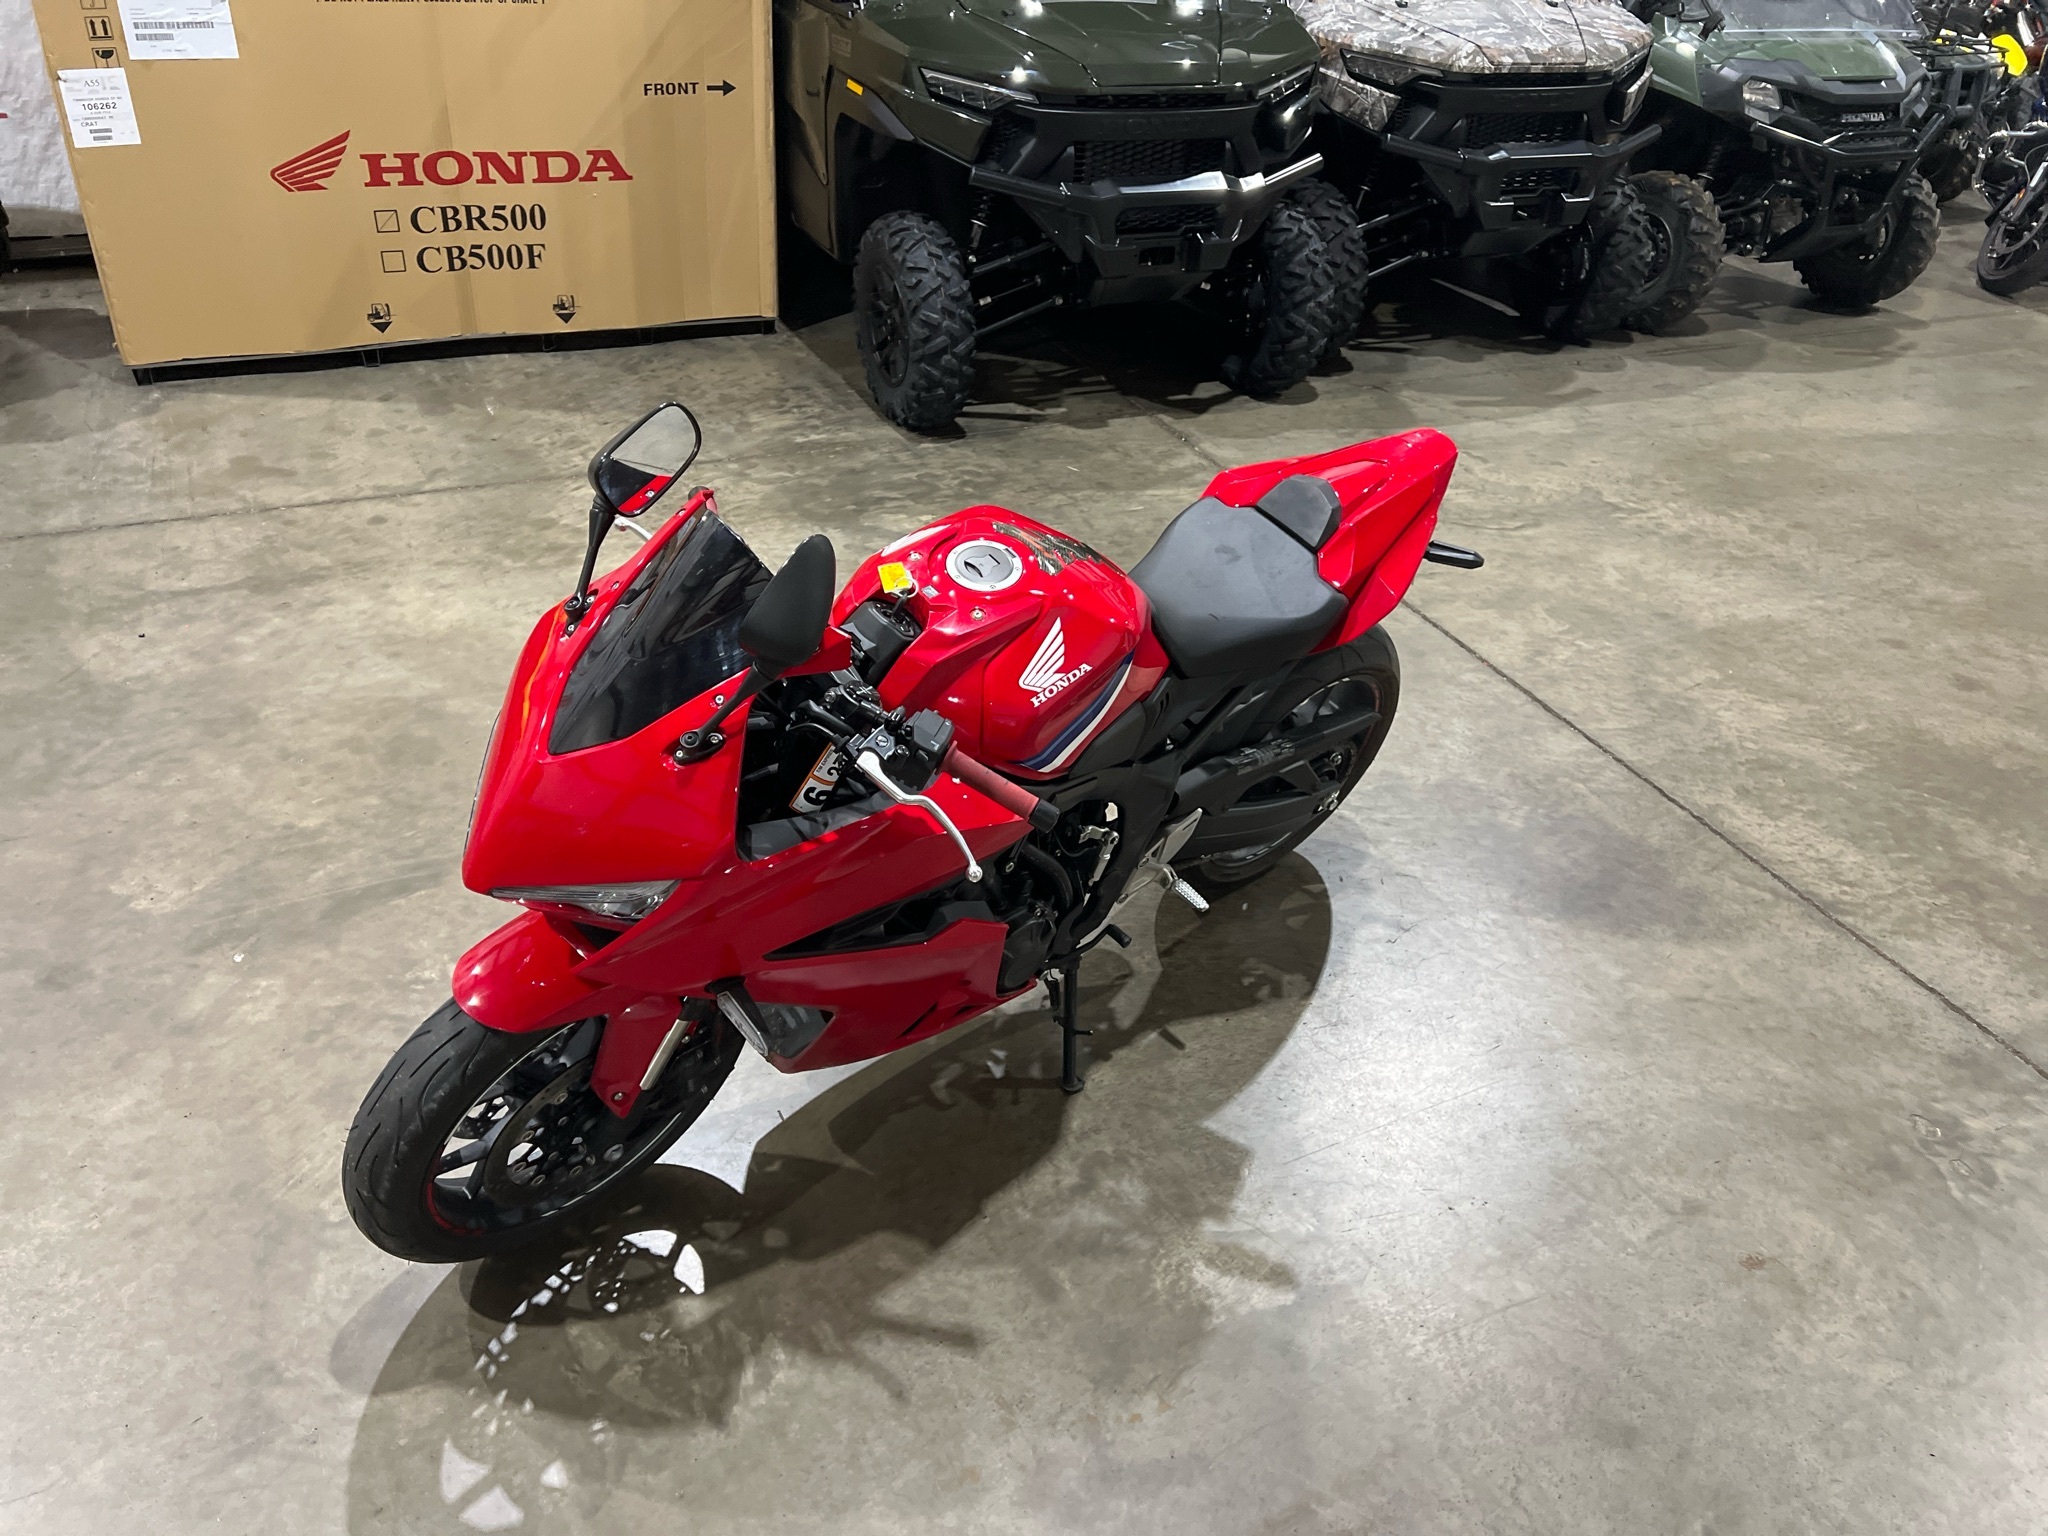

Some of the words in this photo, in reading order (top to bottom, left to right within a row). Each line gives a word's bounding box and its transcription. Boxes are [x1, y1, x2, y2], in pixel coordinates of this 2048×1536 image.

[643, 82, 700, 96] FRONT
[82, 101, 117, 111] 106262
[1841, 111, 1885, 122] HONDA
[359, 149, 633, 187] HONDA
[409, 203, 547, 234] CBR500
[415, 243, 546, 273] CB500F
[1030, 663, 1093, 708] HONDA
[803, 786, 832, 806] 6
